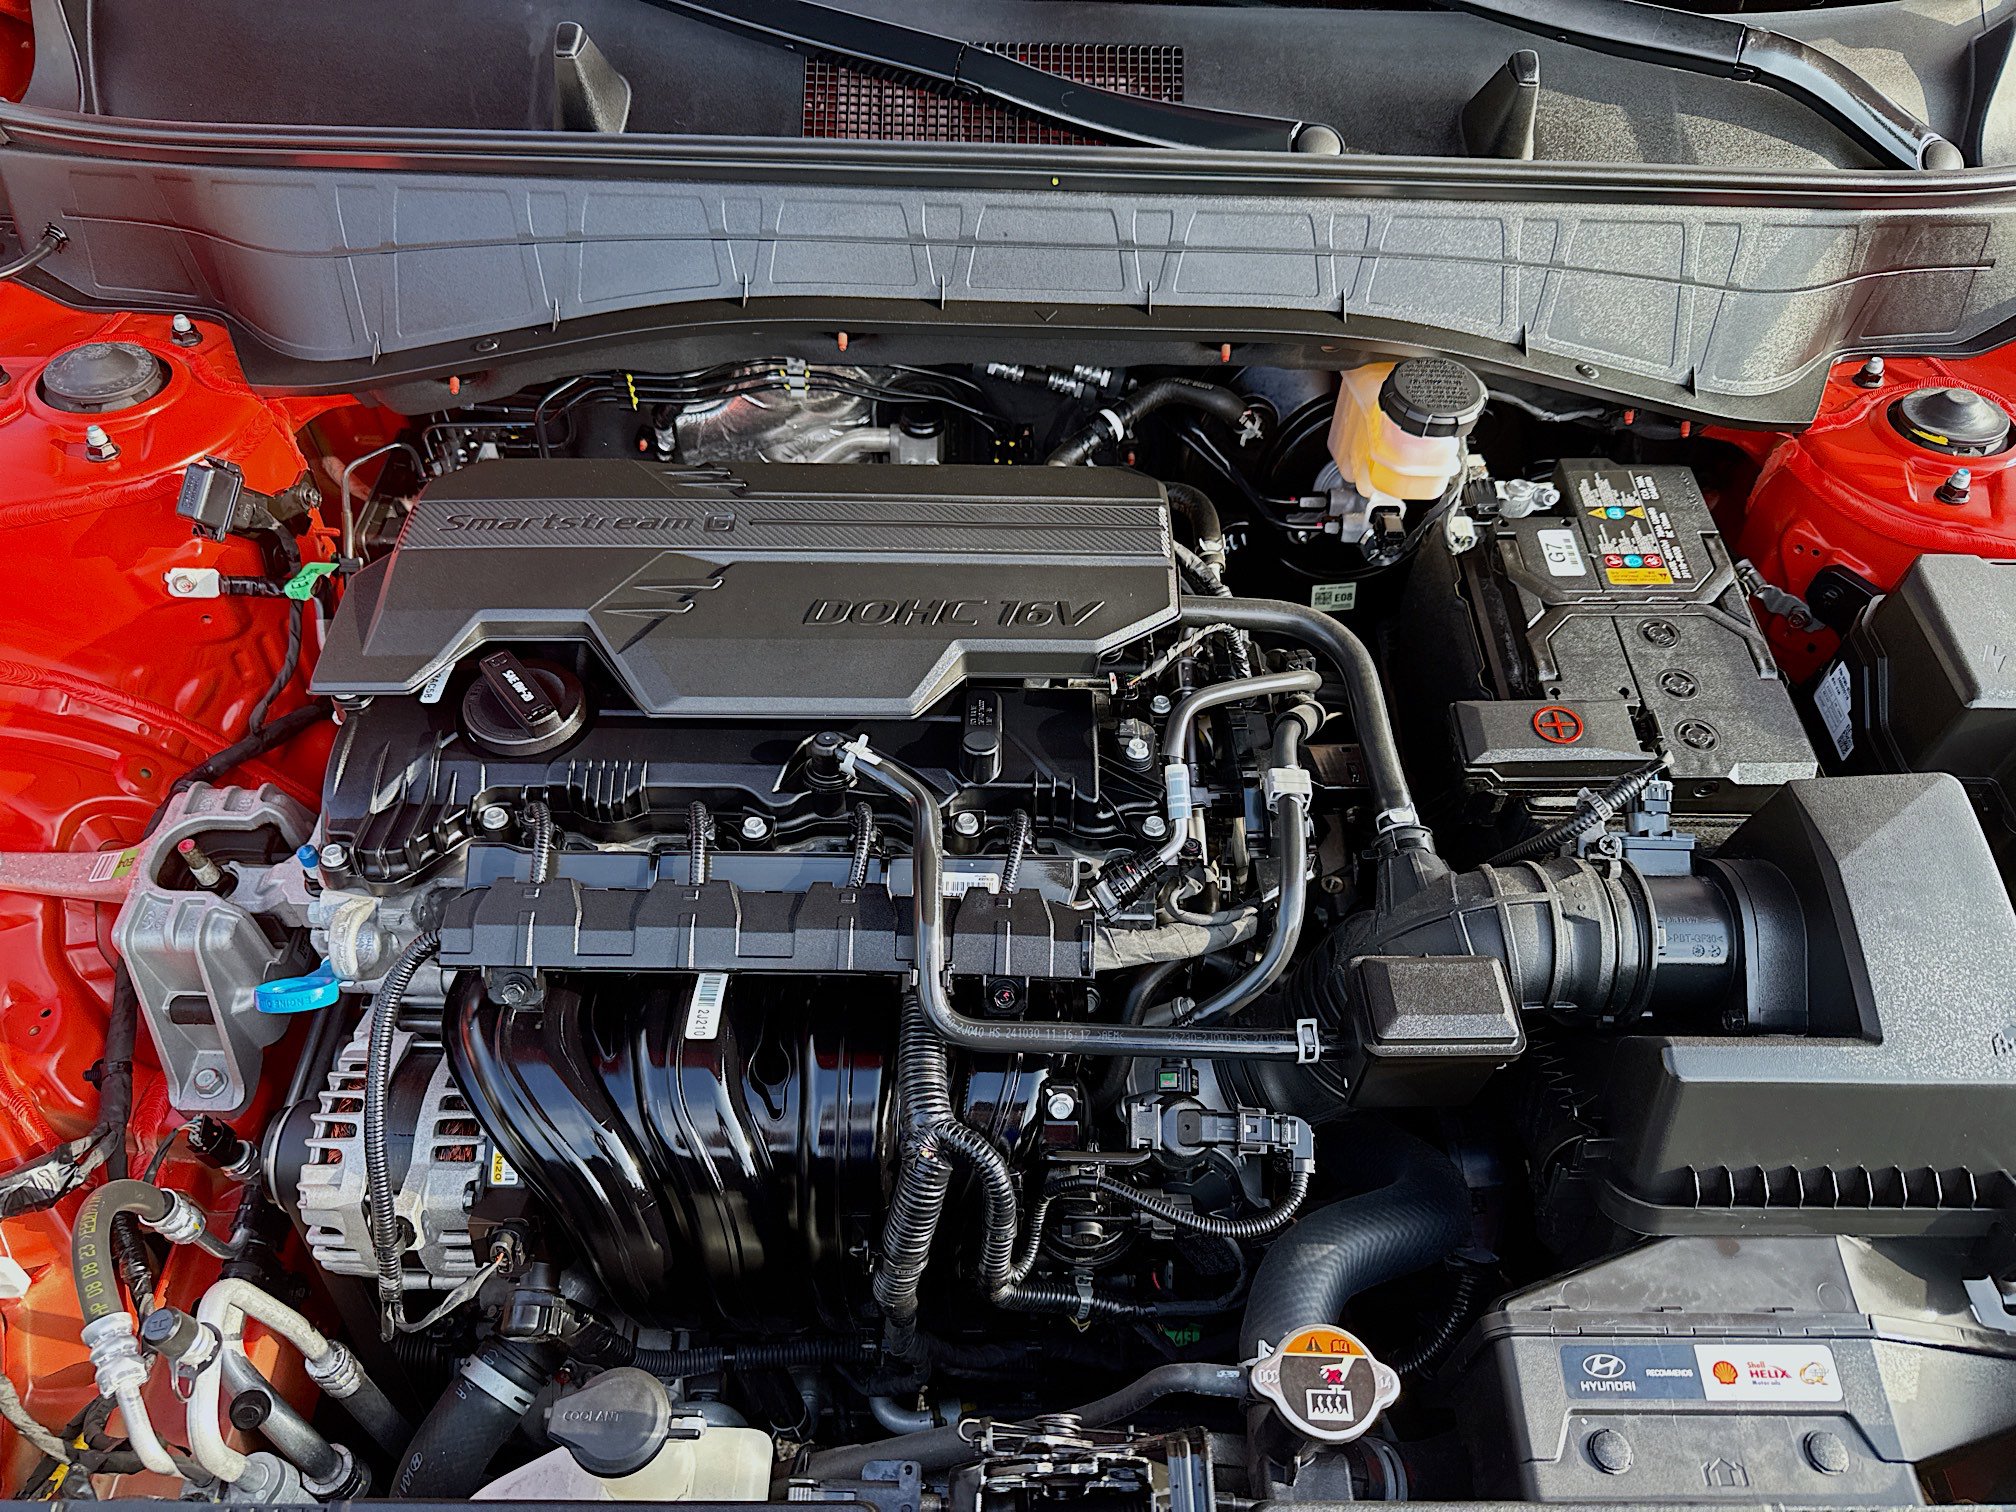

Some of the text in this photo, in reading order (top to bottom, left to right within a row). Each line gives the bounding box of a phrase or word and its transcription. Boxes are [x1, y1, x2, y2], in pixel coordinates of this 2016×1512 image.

[436, 511, 694, 532] Smartstream
[1548, 543, 1566, 563] G7
[1334, 593, 1353, 602] E08
[803, 599, 1105, 628] DOHC 16V
[693, 1008, 711, 1037] 2J210
[988, 1027, 1001, 1038] HS
[1005, 1027, 1040, 1039] 241030
[494, 1155, 503, 1181] N20
[78, 1243, 96, 1260] 23
[81, 1261, 99, 1279] 08
[84, 1280, 104, 1299] 08
[1747, 1361, 1766, 1369] Shell
[1749, 1369, 1793, 1379] HELIX
[1580, 1368, 1694, 1392] HYUNDAI RECOMMENDS
[562, 1410, 620, 1422] COOLANT
